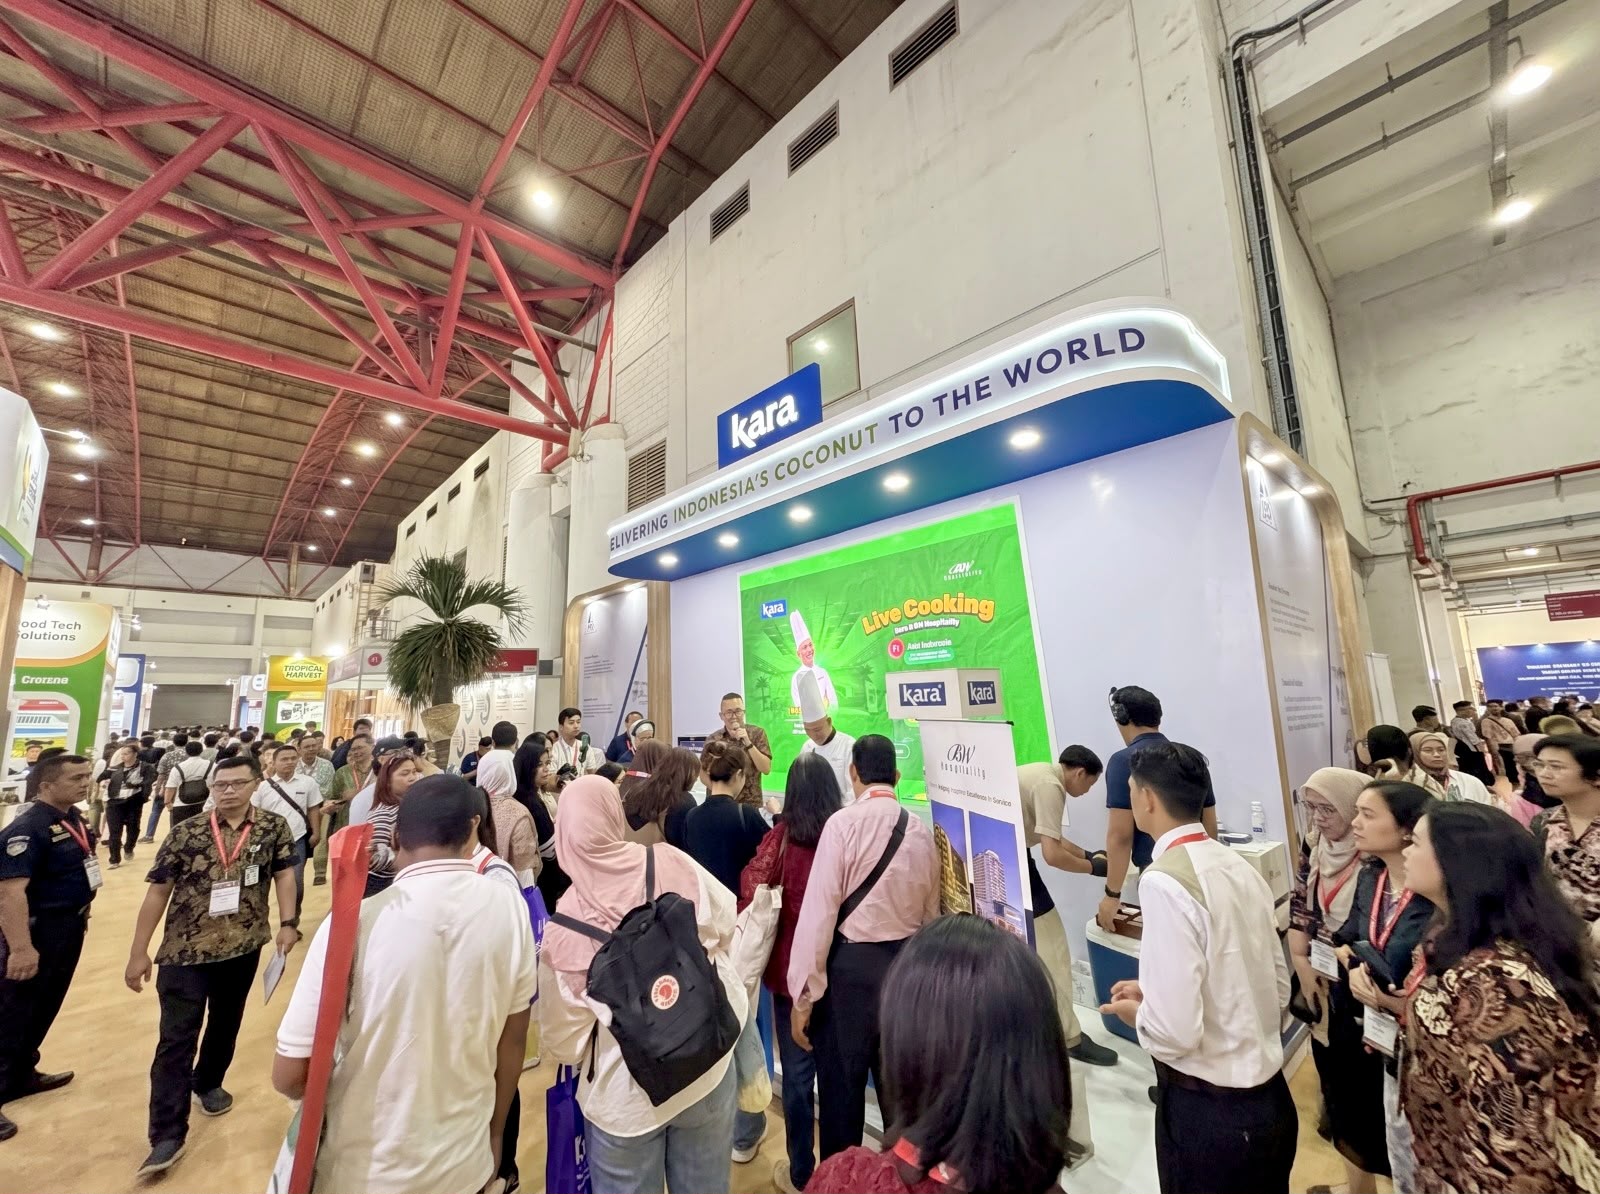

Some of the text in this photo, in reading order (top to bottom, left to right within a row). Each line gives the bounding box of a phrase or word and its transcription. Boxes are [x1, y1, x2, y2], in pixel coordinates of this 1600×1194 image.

[731, 394, 799, 449] kara
[610, 328, 1146, 551] ELIVERING INDONESIA'S COCONUT TO THE WORLD
[762, 603, 785, 618] kara
[862, 607, 902, 635] Live
[903, 592, 995, 622] Cooking
[21, 620, 81, 630] ood Tech
[286, 671, 322, 679] HARVEST
[903, 685, 941, 706] kara
[970, 682, 994, 704] kara
